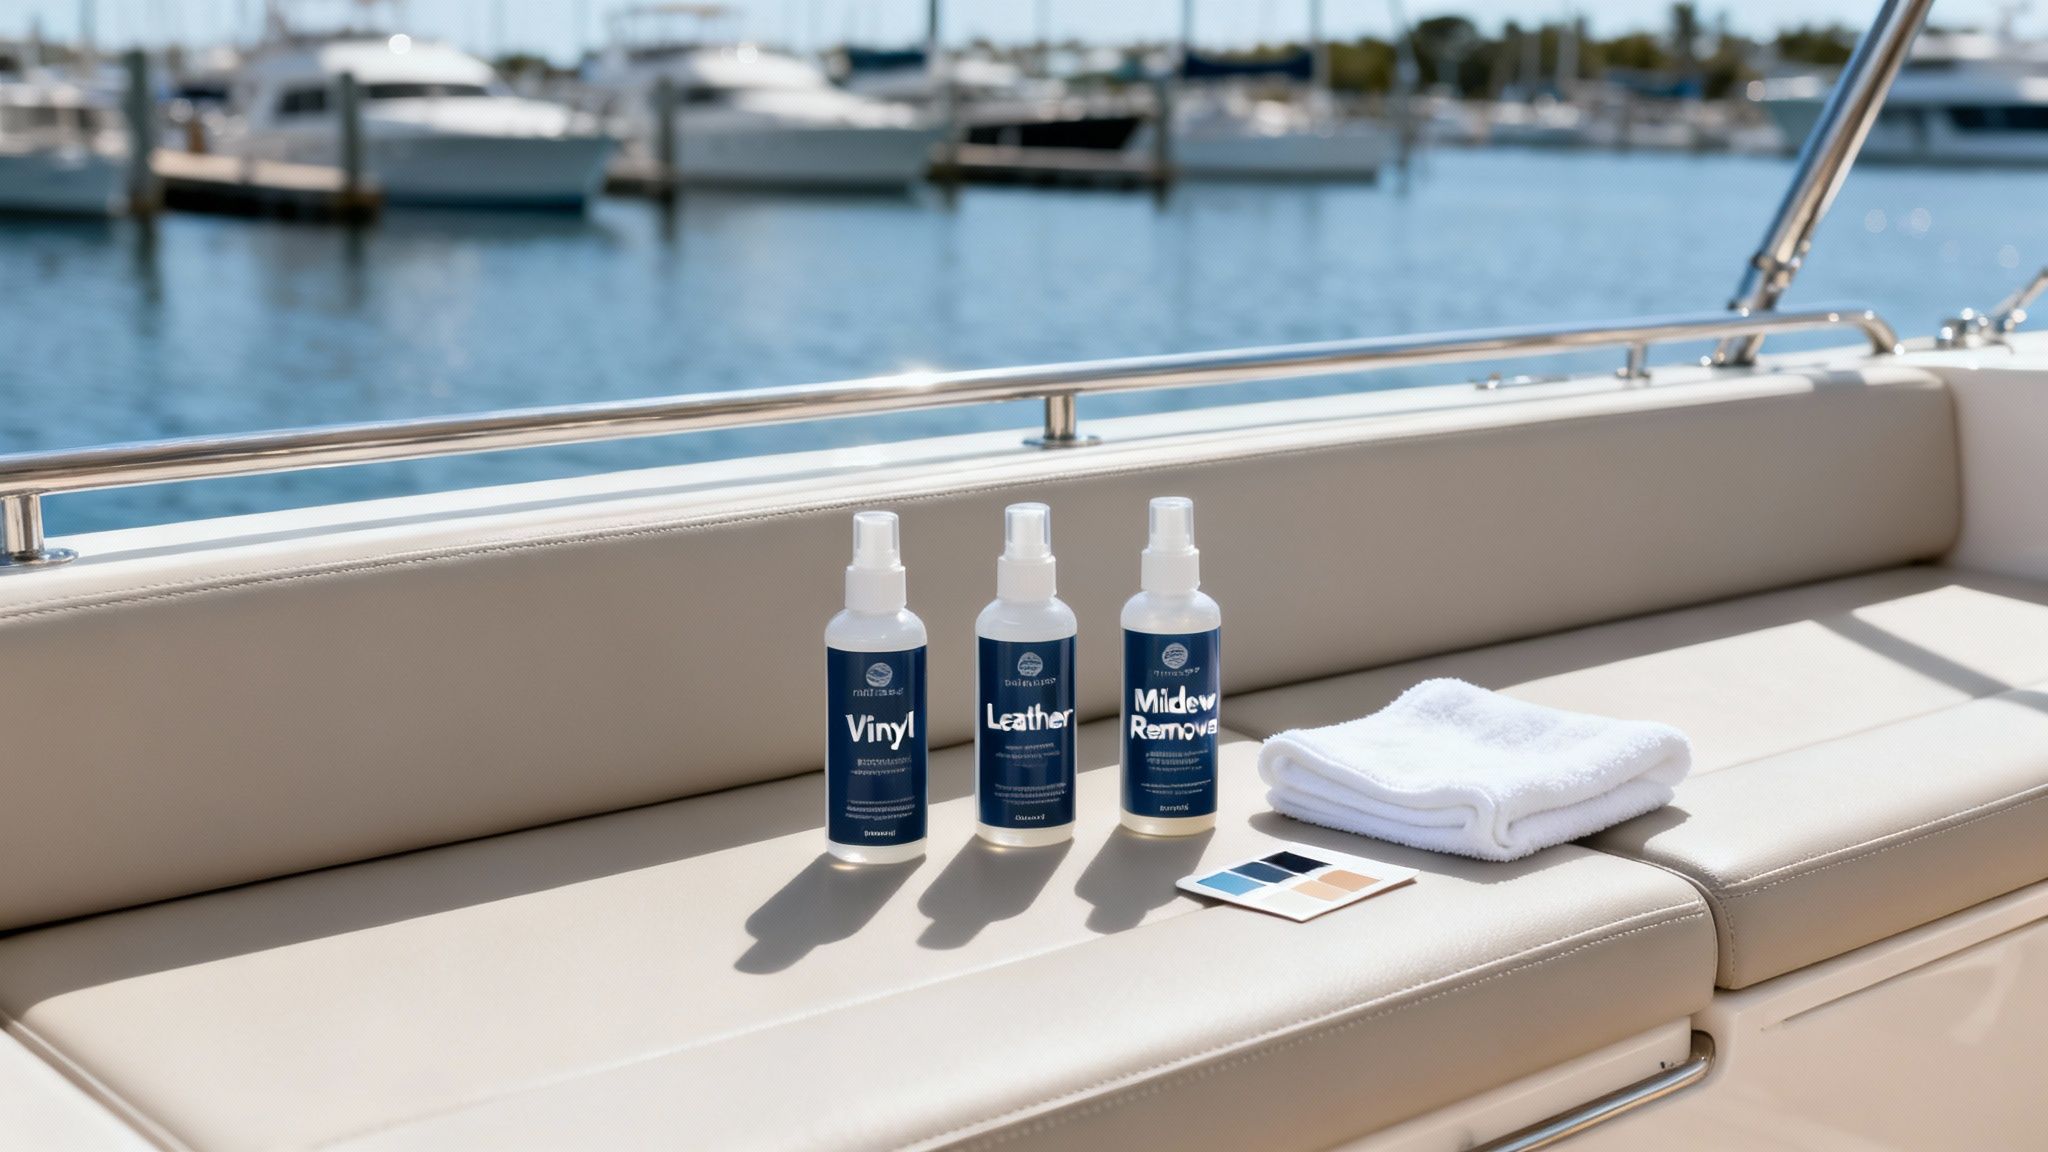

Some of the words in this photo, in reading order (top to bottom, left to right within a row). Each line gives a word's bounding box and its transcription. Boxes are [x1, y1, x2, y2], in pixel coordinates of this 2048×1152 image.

[1134, 685, 1216, 714] Mildew
[845, 710, 915, 751] Vinyl
[987, 703, 1074, 732] Leather
